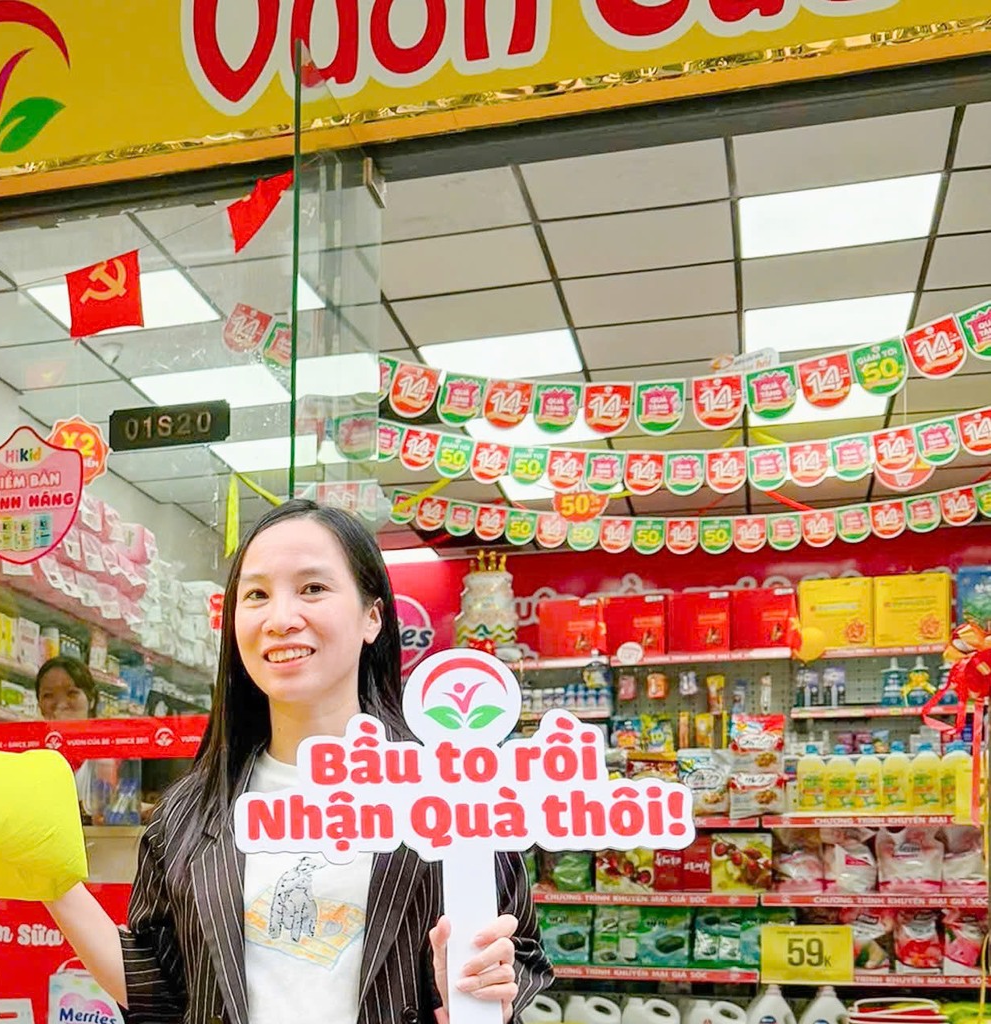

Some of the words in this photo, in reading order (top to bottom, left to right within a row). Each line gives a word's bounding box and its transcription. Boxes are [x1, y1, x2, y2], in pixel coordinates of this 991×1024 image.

[916, 331, 955, 365] 14
[398, 374, 430, 400] 14
[806, 364, 843, 394] 14
[491, 389, 522, 415] 14
[589, 393, 622, 419] 14
[699, 385, 733, 412] 14
[125, 411, 211, 441] 01S20
[405, 437, 431, 458] 14
[476, 450, 501, 470] 14
[878, 436, 907, 460] 14
[551, 458, 578, 480] 14
[630, 459, 657, 481] 14
[712, 458, 739, 478] 14
[793, 451, 822, 473] 14
[311, 720, 422, 784] Bầu
[435, 741, 498, 781] to
[514, 717, 599, 782] rồi
[247, 790, 394, 851] Nhận
[410, 787, 528, 847] Quà
[541, 786, 687, 837] thôi!
